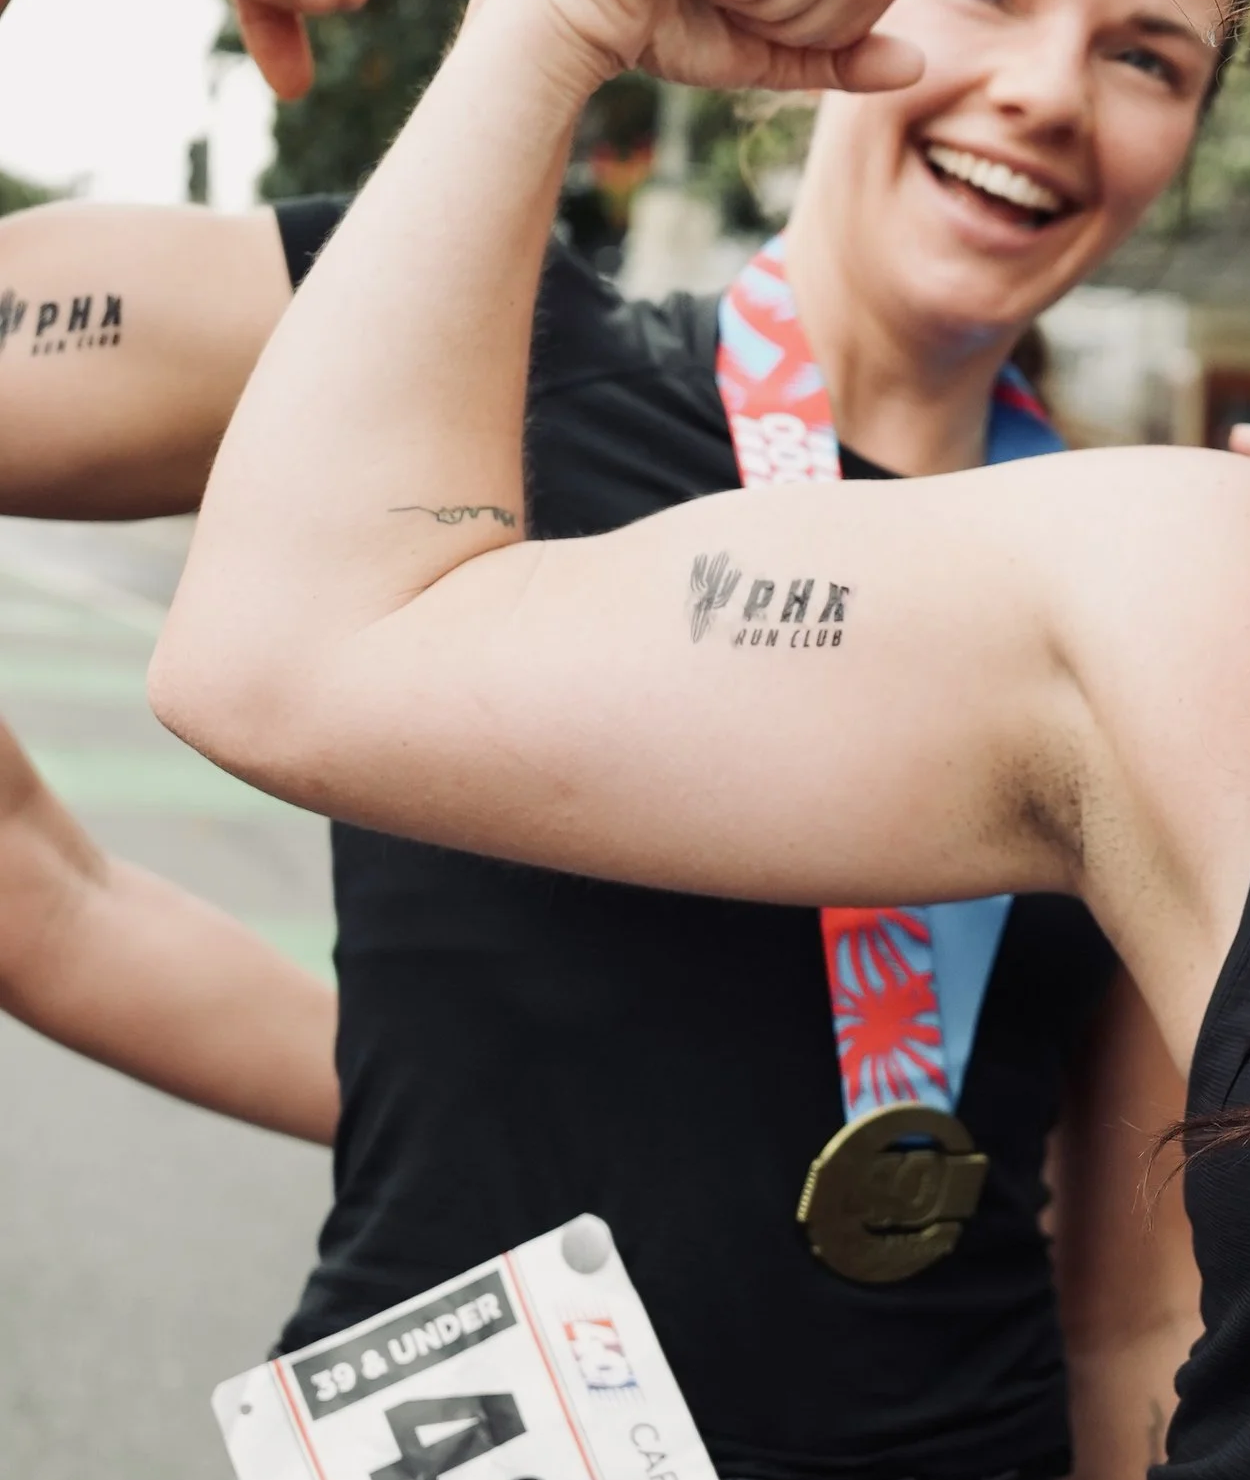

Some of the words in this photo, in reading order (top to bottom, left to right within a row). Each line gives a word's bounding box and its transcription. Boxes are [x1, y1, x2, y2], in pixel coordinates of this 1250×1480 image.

[36, 294, 121, 336] PHX
[743, 579, 850, 623] PHX
[735, 629, 779, 647] RUN
[790, 629, 843, 647] CLUB
[310, 1362, 356, 1402] 39
[360, 1349, 388, 1380] &
[387, 1293, 503, 1365] UNDER
